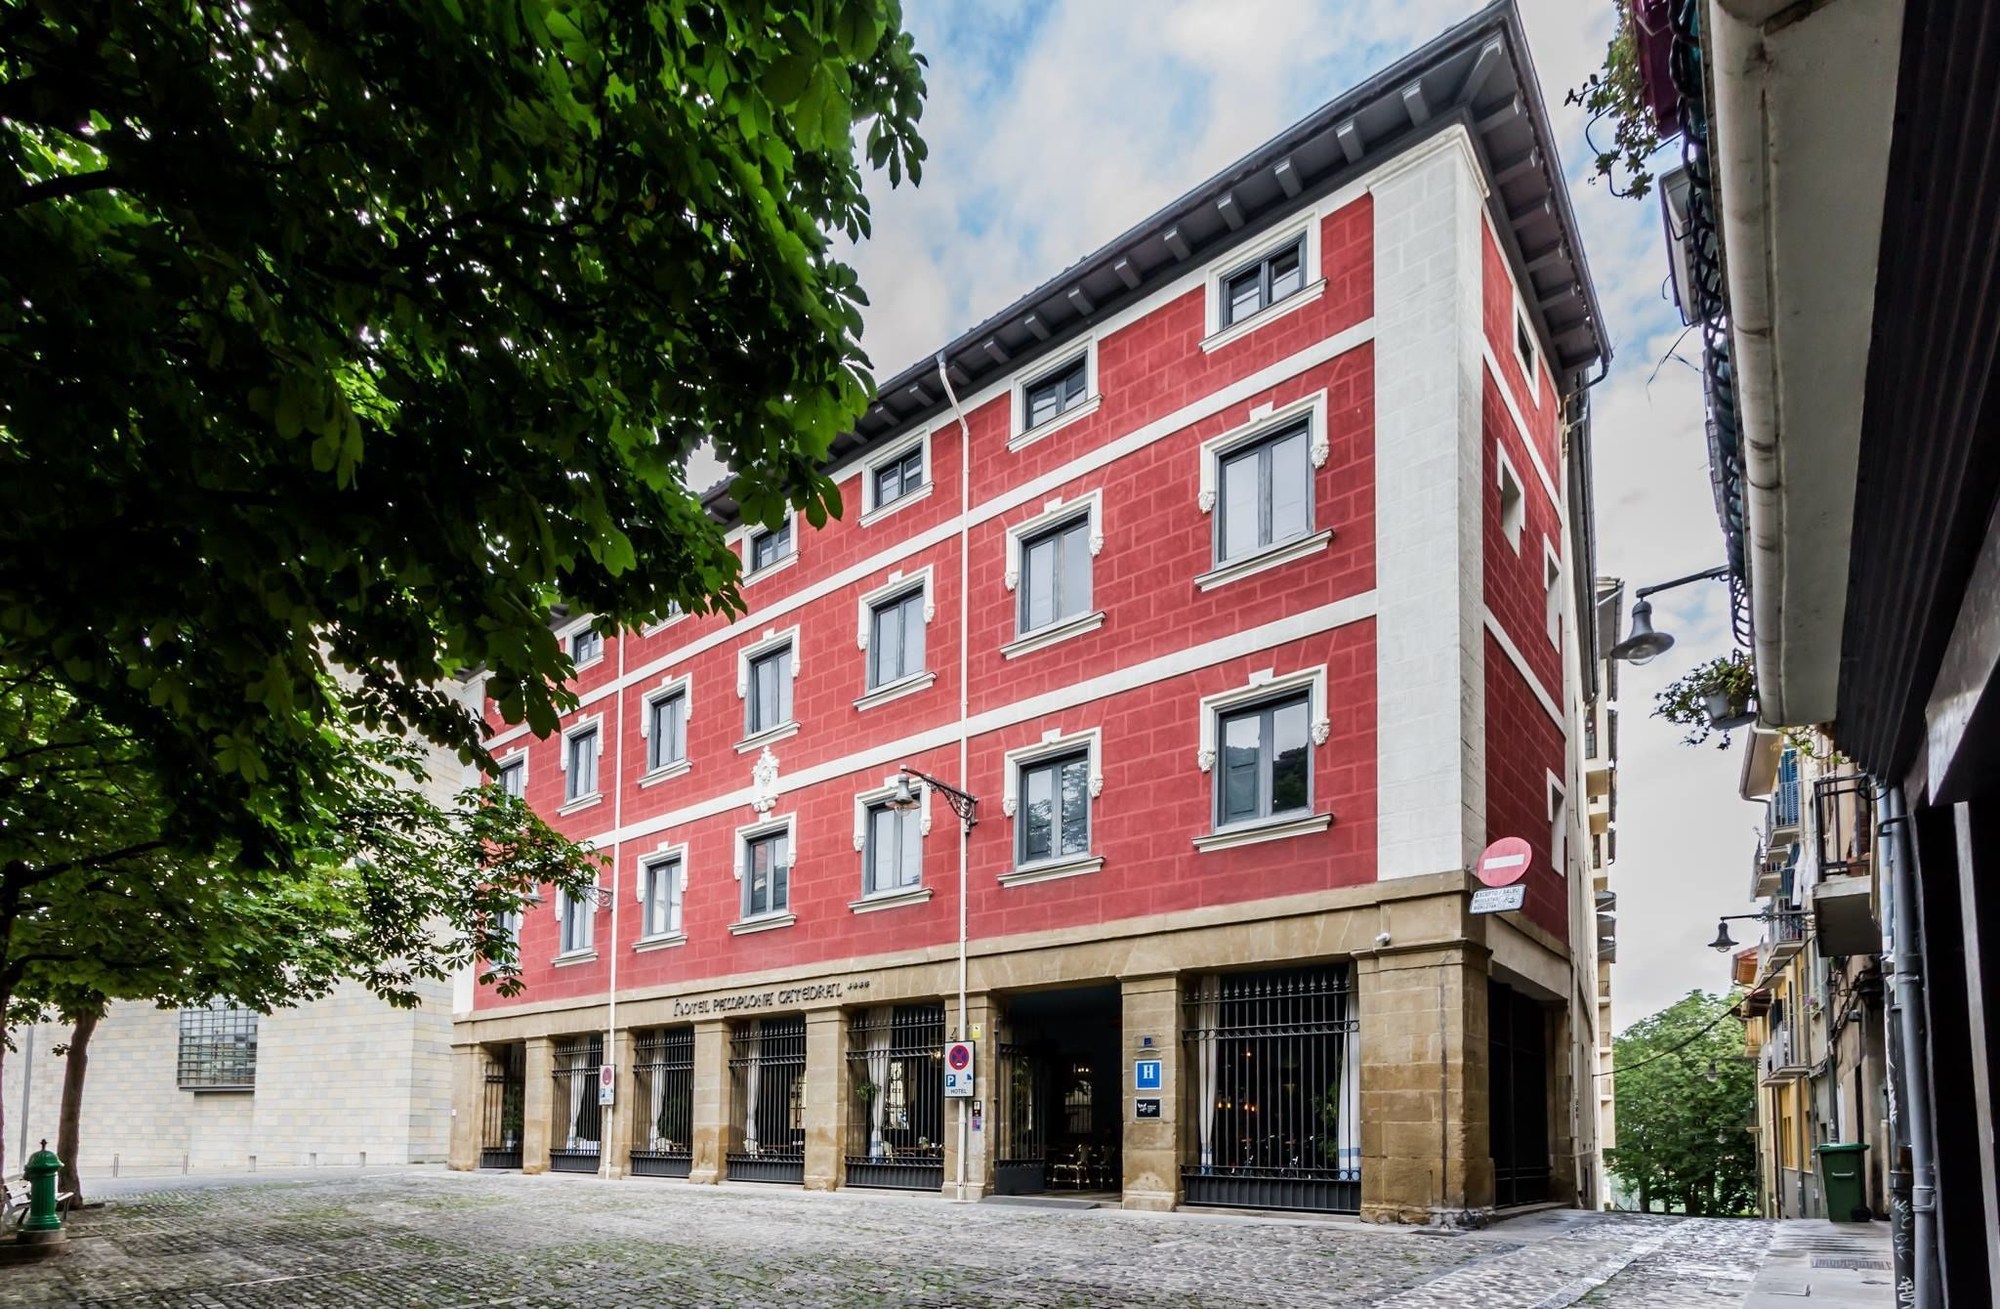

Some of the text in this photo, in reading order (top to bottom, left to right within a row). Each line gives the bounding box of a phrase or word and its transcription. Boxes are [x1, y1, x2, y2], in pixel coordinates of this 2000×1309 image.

[713, 992, 774, 1013] PAMPLONA
[778, 983, 843, 1004] CATEDRAL
[1143, 1064, 1154, 1079] H
[947, 1075, 955, 1086] P
